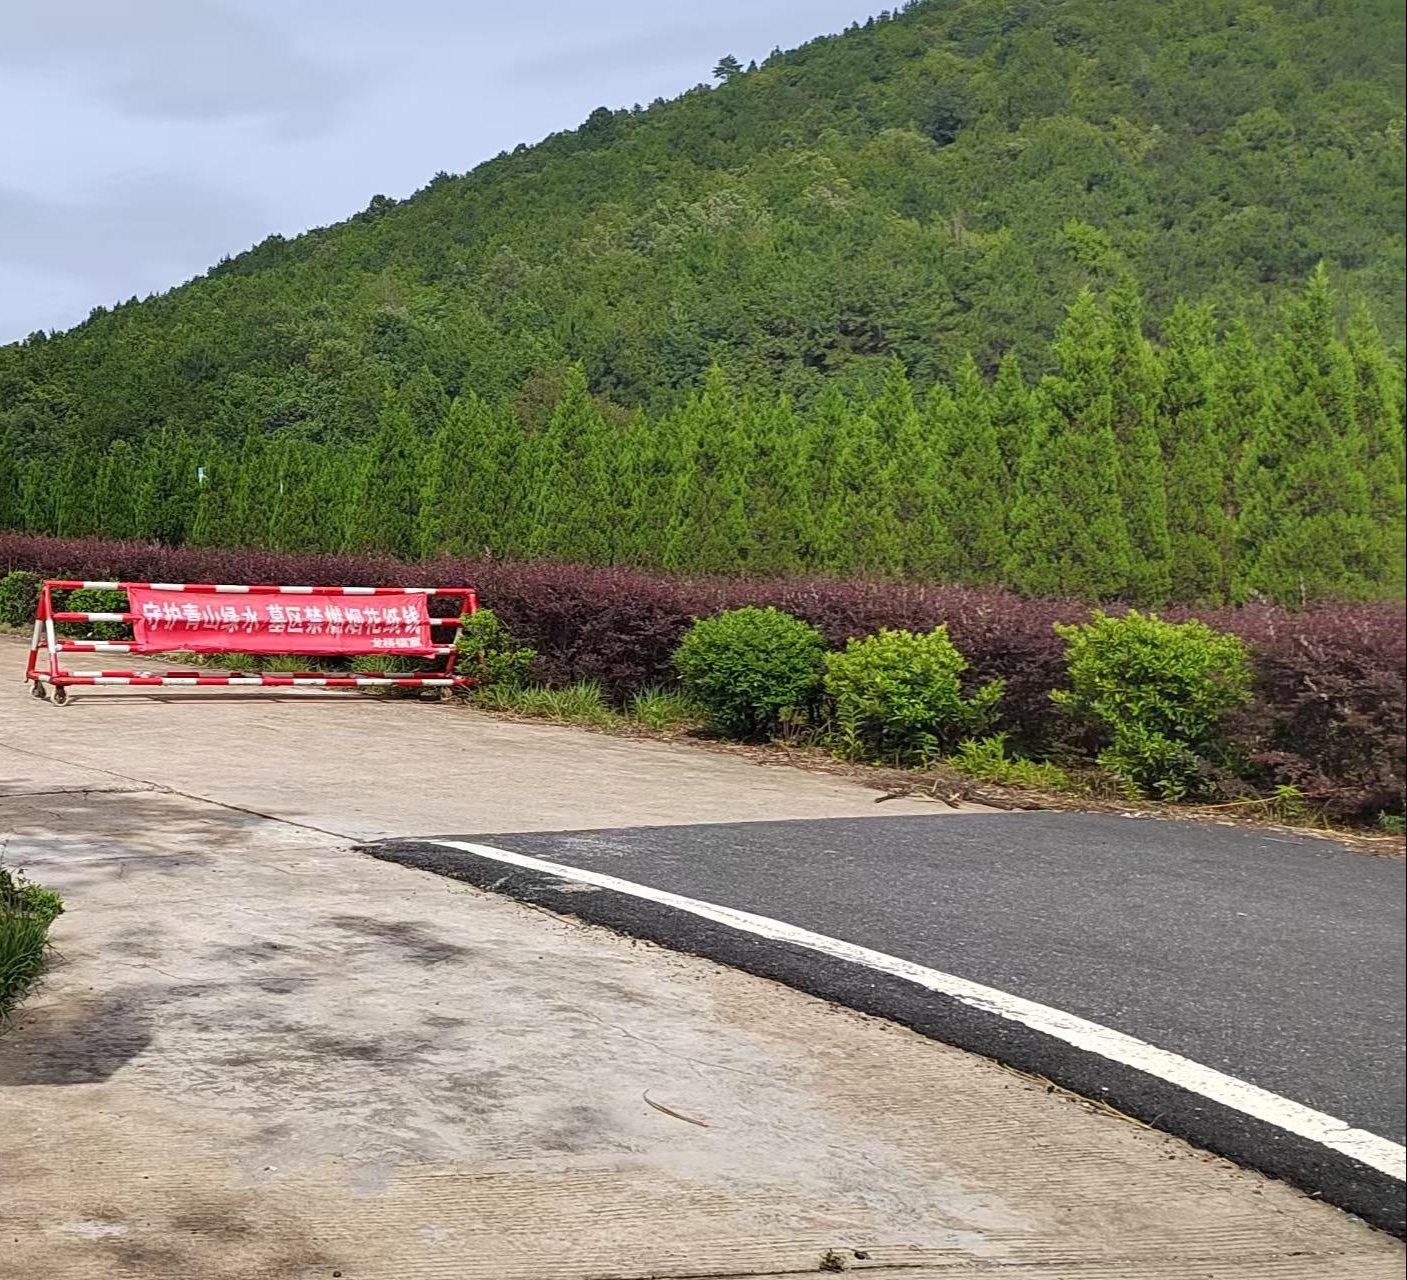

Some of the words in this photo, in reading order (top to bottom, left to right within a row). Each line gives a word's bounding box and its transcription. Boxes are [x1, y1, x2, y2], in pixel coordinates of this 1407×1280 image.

[142, 601, 259, 634] 守护青山绿水
